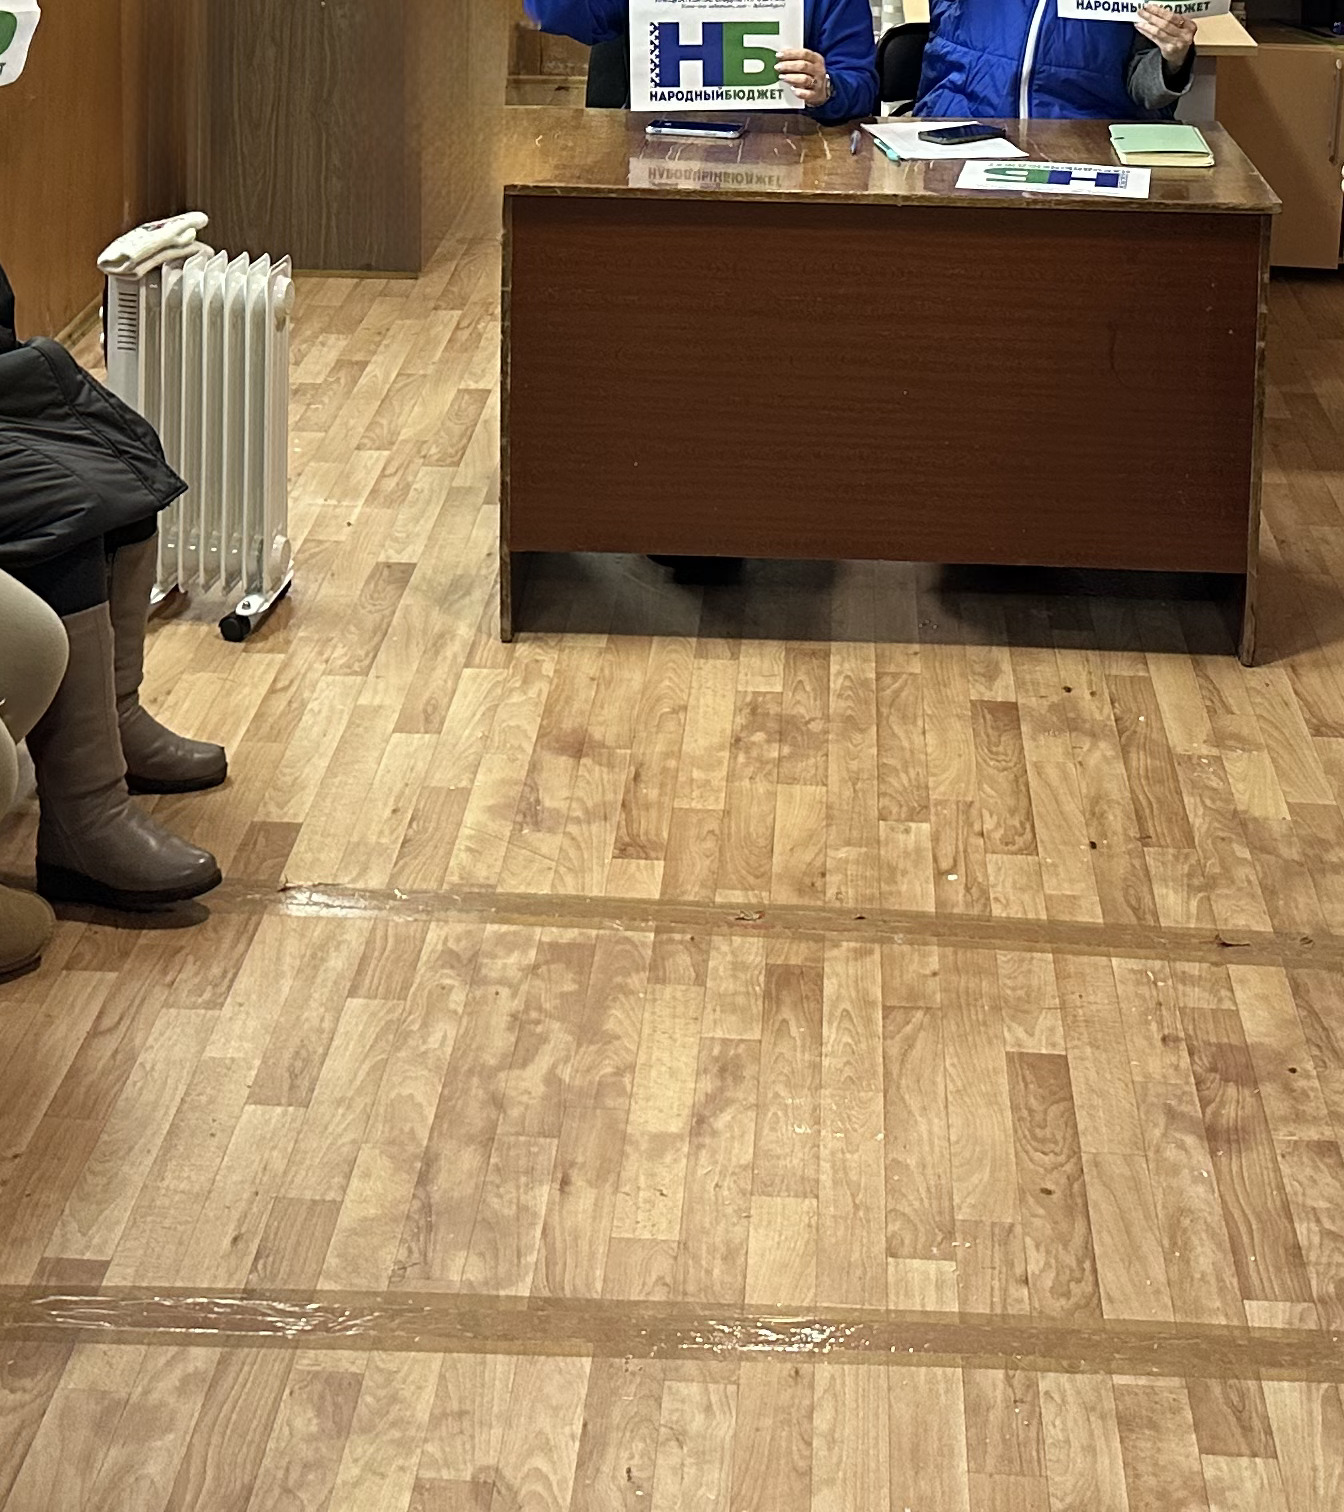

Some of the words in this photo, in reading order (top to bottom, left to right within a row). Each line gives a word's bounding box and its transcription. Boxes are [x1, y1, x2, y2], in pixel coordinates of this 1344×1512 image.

[1076, 0, 1211, 15] НАРОДНЫДЖЕТ
[650, 21, 780, 87] НБ
[650, 87, 784, 102] НАРОДНЫЙБЮДЖЕТ
